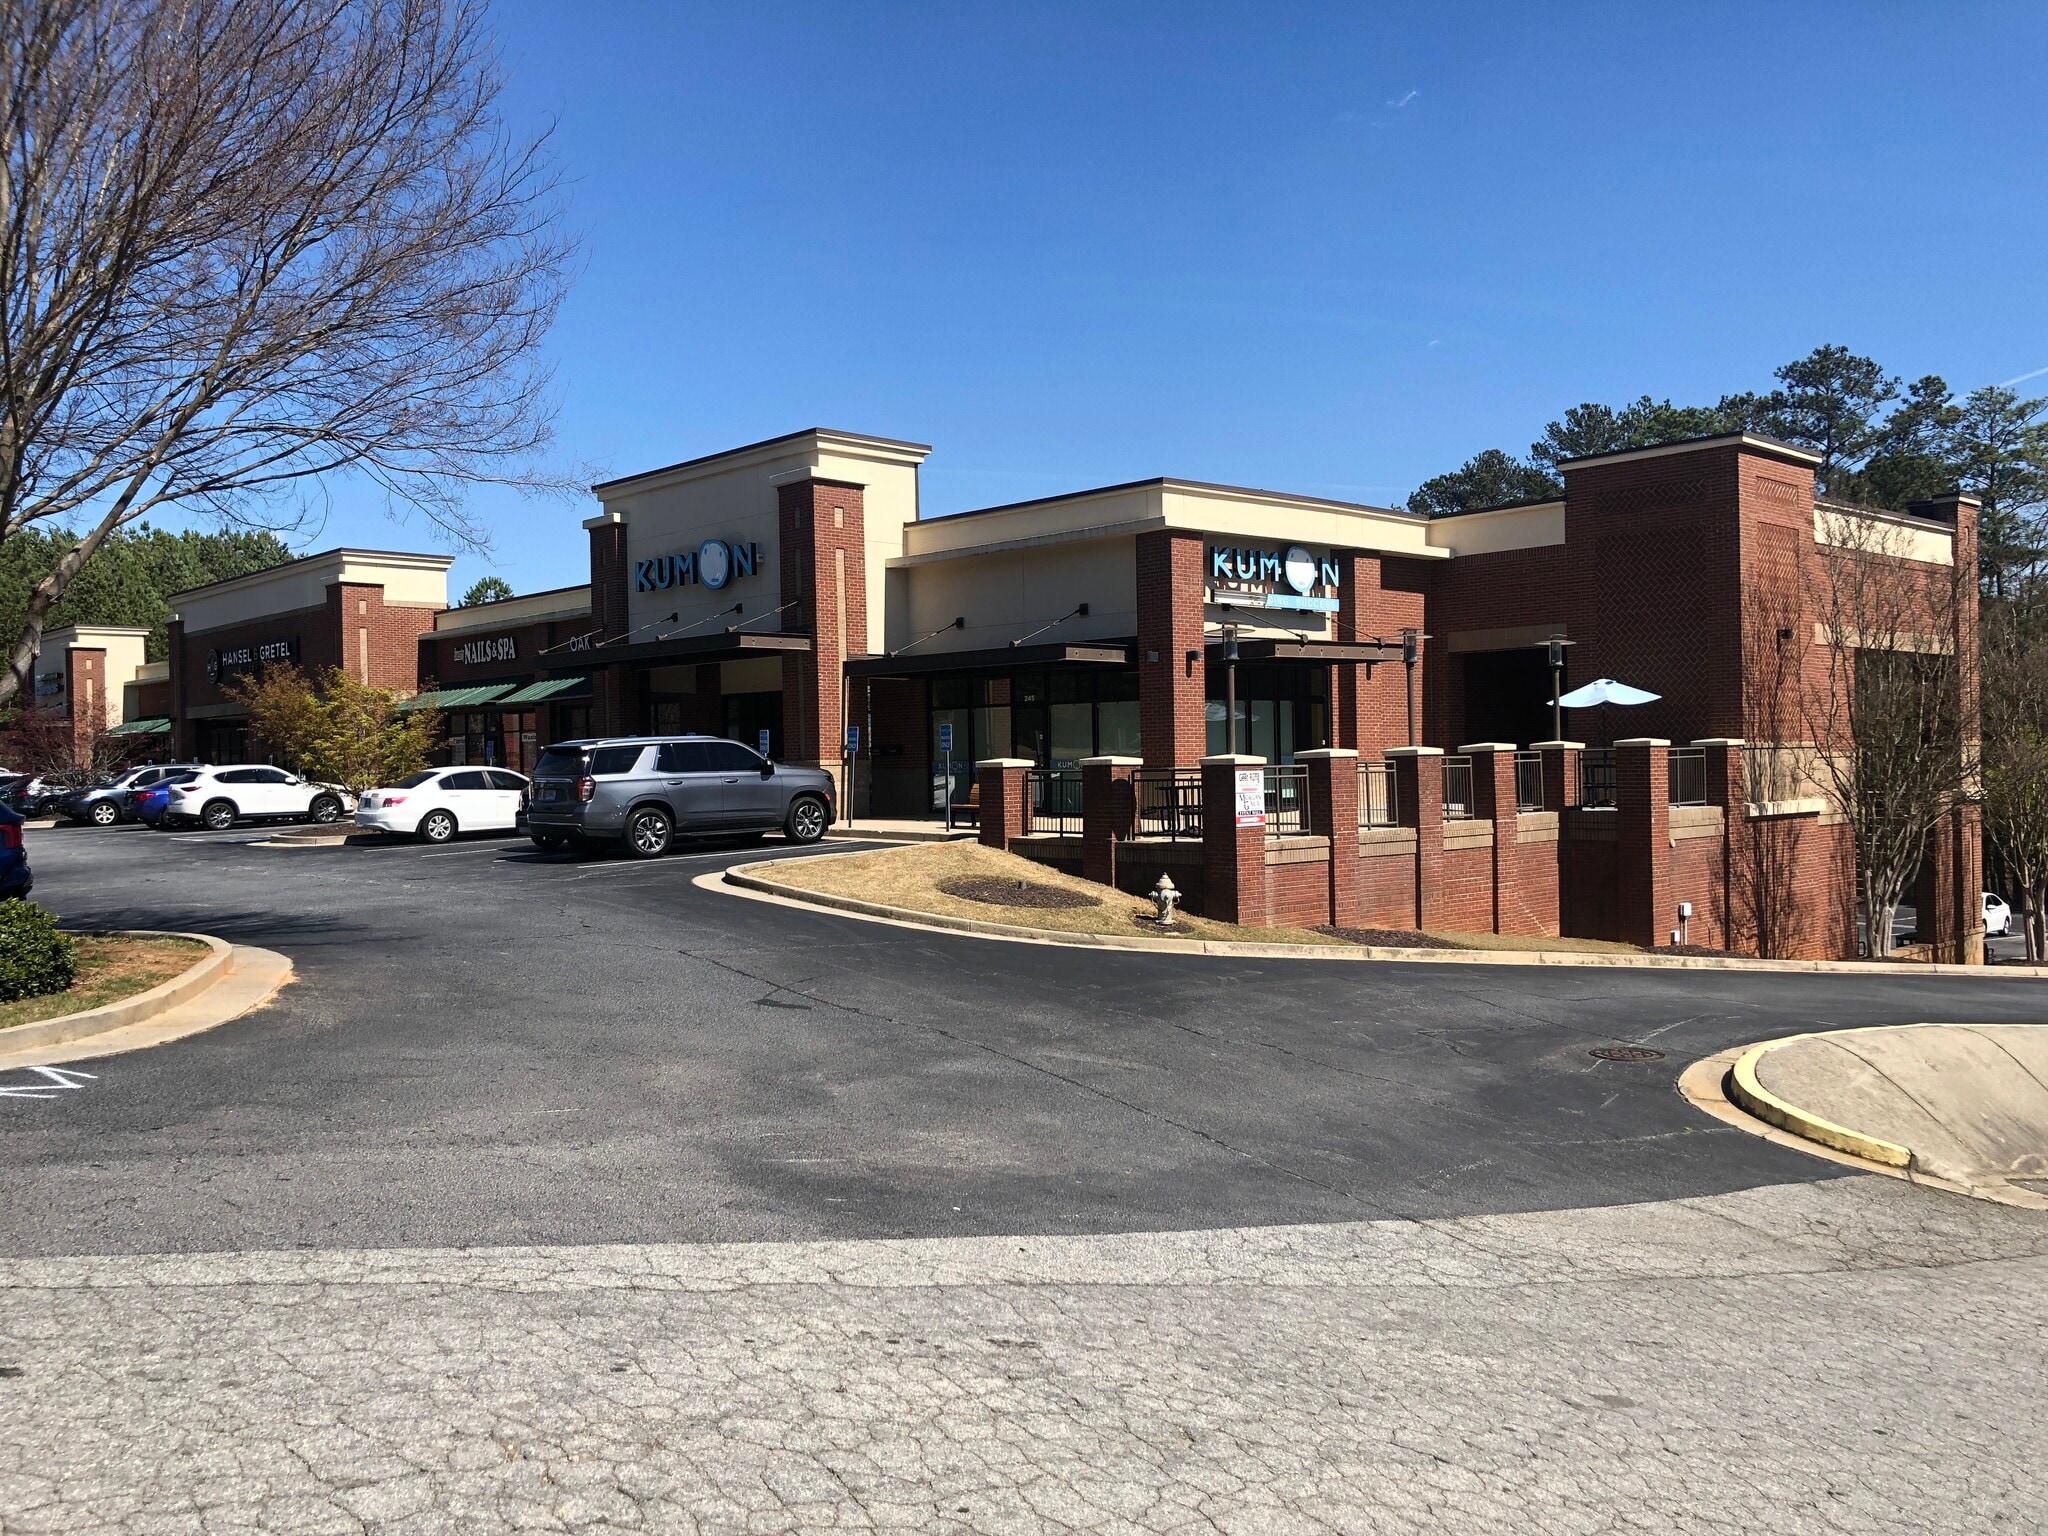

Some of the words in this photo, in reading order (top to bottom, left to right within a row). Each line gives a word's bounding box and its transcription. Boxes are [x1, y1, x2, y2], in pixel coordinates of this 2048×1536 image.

[635, 538, 757, 592] KUMON
[1210, 545, 1339, 593] KUMON
[1295, 597, 1337, 610] SUCCESS
[222, 649, 252, 666] HANSEL
[259, 642, 290, 659] GRETEL
[569, 635, 590, 652] OAK
